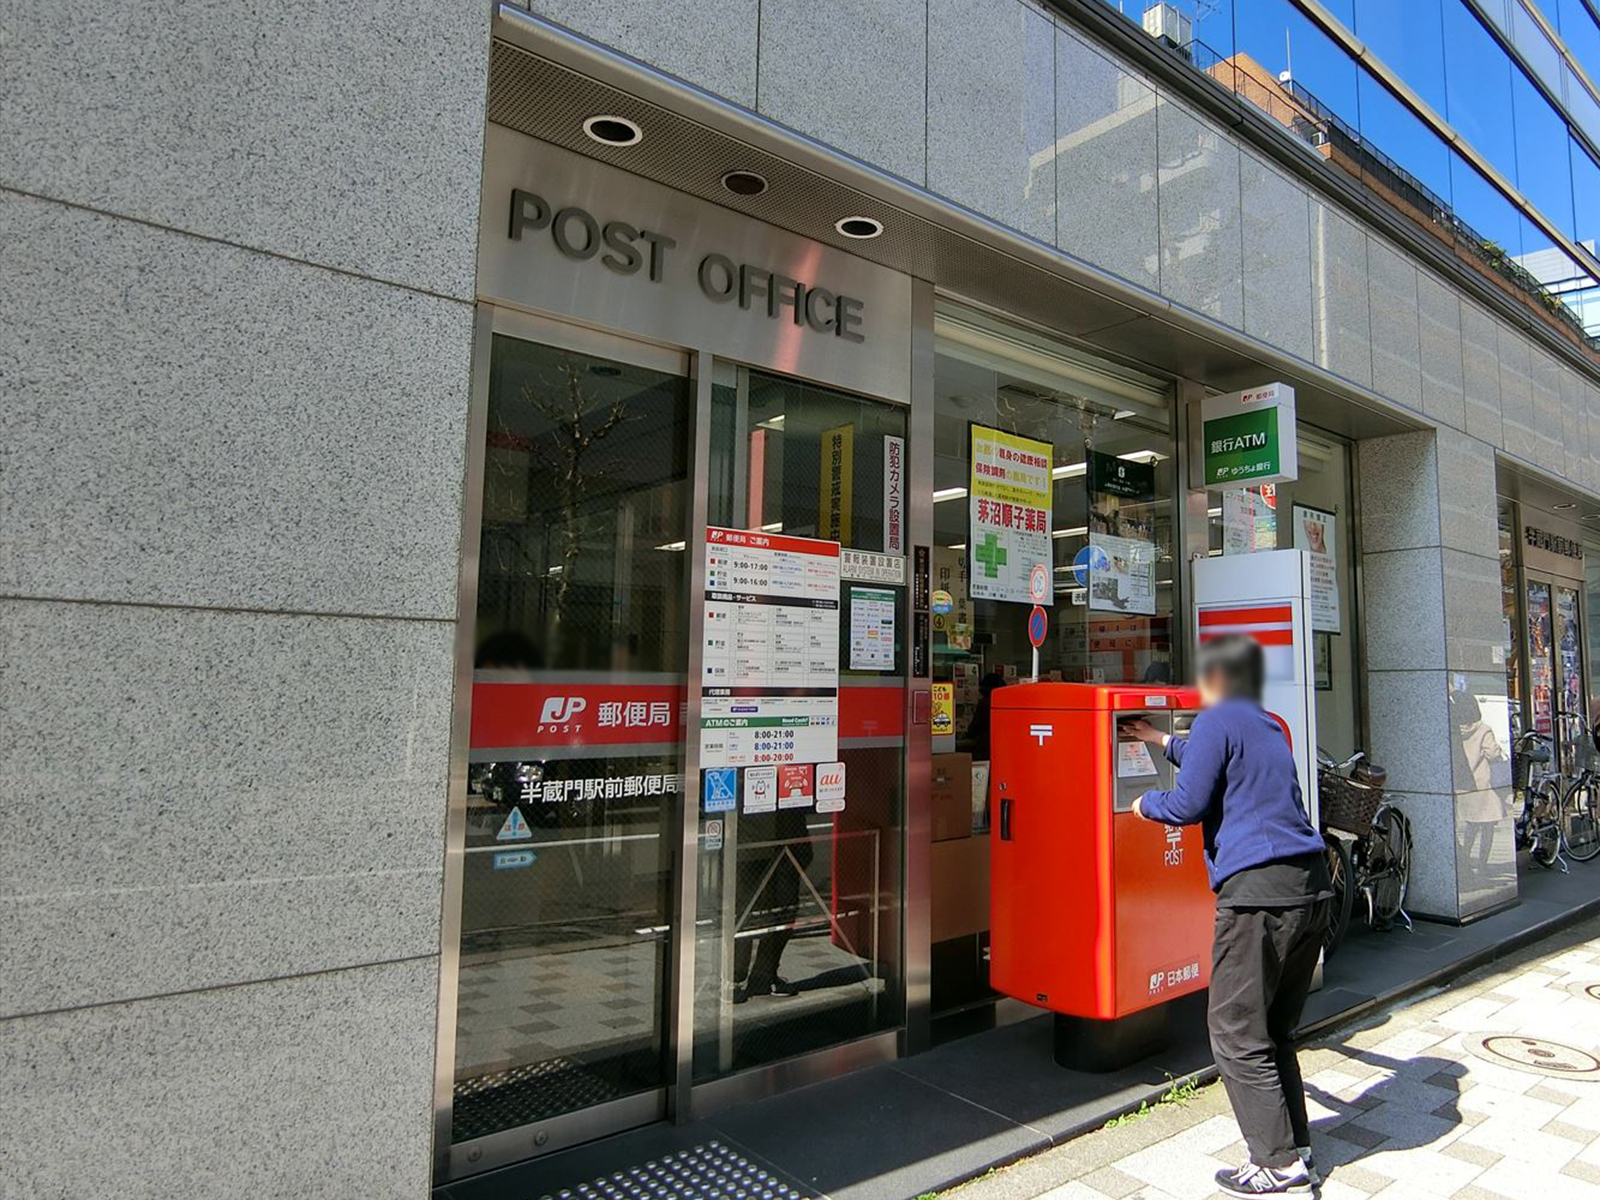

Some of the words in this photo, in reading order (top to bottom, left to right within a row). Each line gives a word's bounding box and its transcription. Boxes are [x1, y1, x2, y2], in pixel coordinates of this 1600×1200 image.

[508, 188, 676, 283] POST
[698, 253, 865, 344] OFFICE
[1210, 432, 1266, 454] 銀行ATM
[1231, 461, 1271, 476] ゆうちょ銀行
[888, 441, 901, 550] 防犯カメラ設置局
[978, 498, 1047, 534] 茅沼順子薬局
[726, 532, 747, 544] 郵便局
[749, 536, 770, 547] ご案内
[733, 561, 768, 571] 9:00-17:00
[733, 577, 768, 587] 9:00-16:00
[539, 696, 587, 724] JP
[598, 702, 670, 727] 郵便局
[537, 724, 583, 733] POST
[705, 718, 749, 727] ATMのご案内
[754, 730, 794, 739] 8:00-21:00
[754, 741, 794, 751] 8:00-21:00
[754, 753, 794, 763] 8:00-20:00
[820, 773, 842, 787] au
[520, 774, 679, 804] 半蔵門駅前郵便局
[1164, 849, 1184, 867] POST
[1149, 971, 1165, 990] JP
[1167, 962, 1200, 987] 日本郵便
